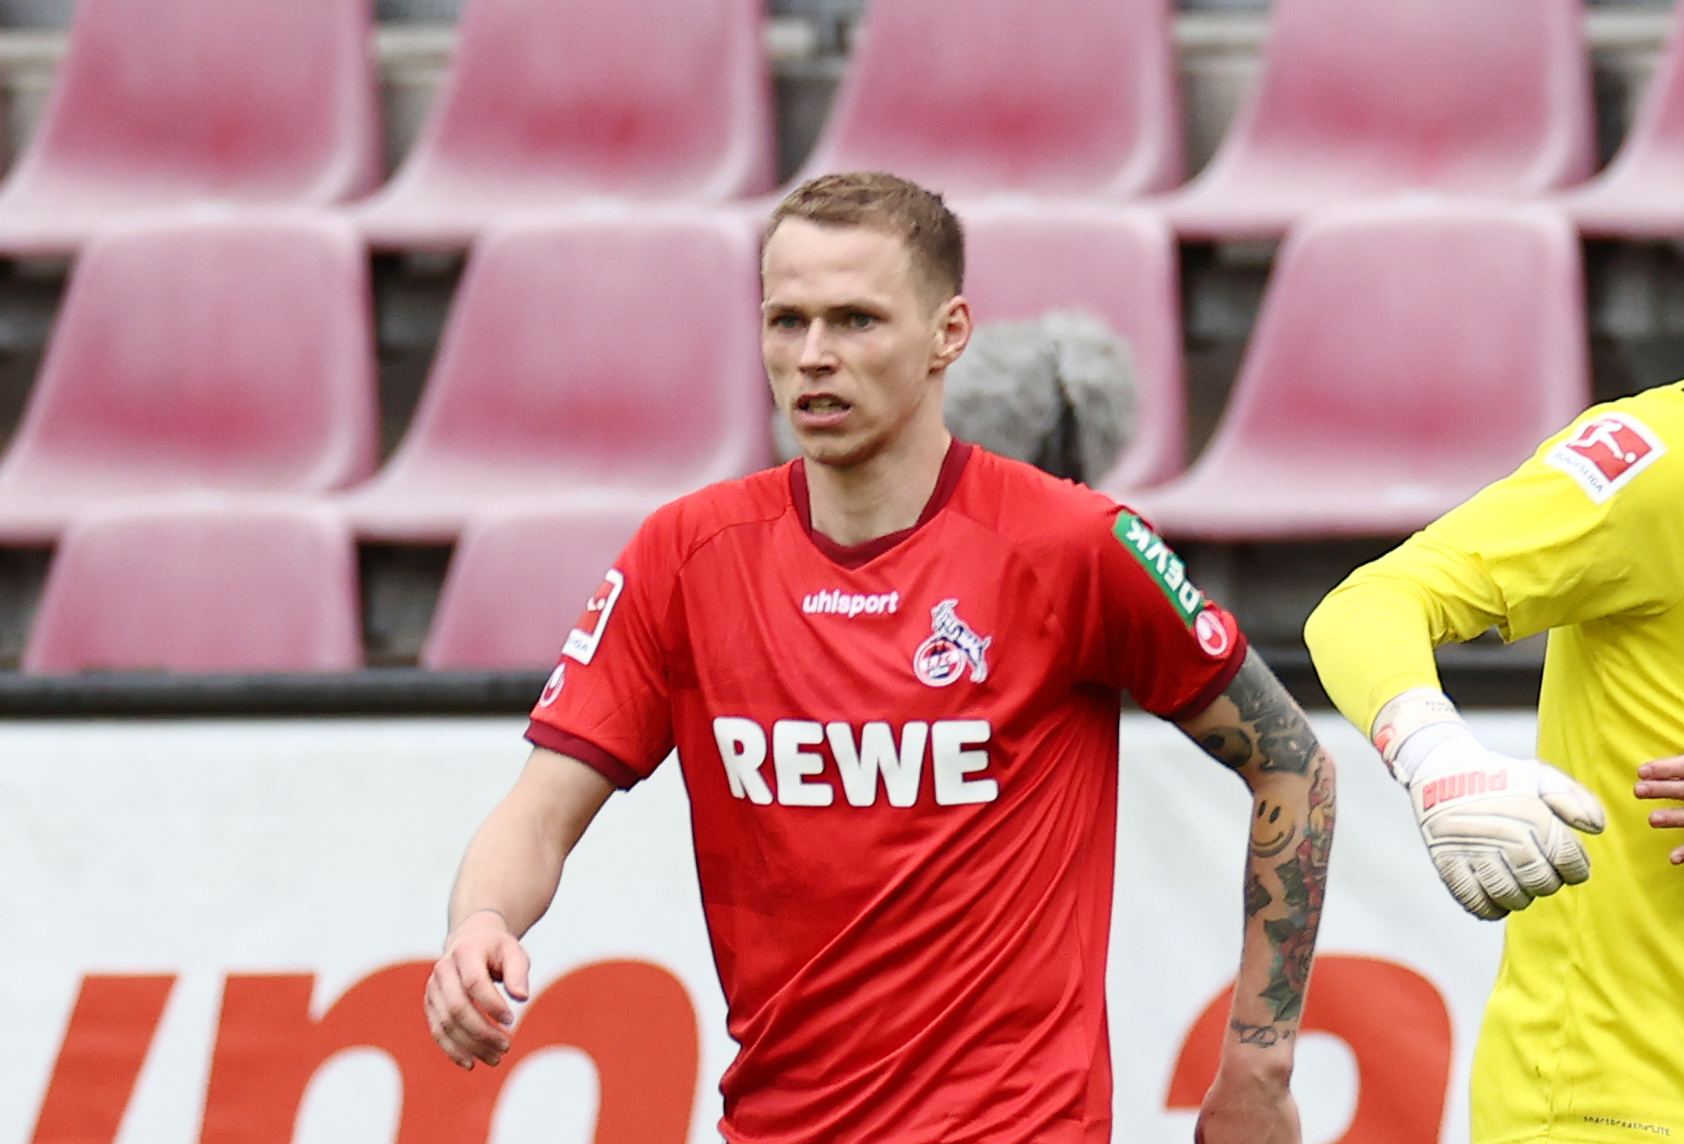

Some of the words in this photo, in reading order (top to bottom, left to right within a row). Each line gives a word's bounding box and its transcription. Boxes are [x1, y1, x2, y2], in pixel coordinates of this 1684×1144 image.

[802, 588, 899, 619] uhlsport
[1125, 518, 1200, 615] DEVK
[712, 716, 999, 808] REWE
